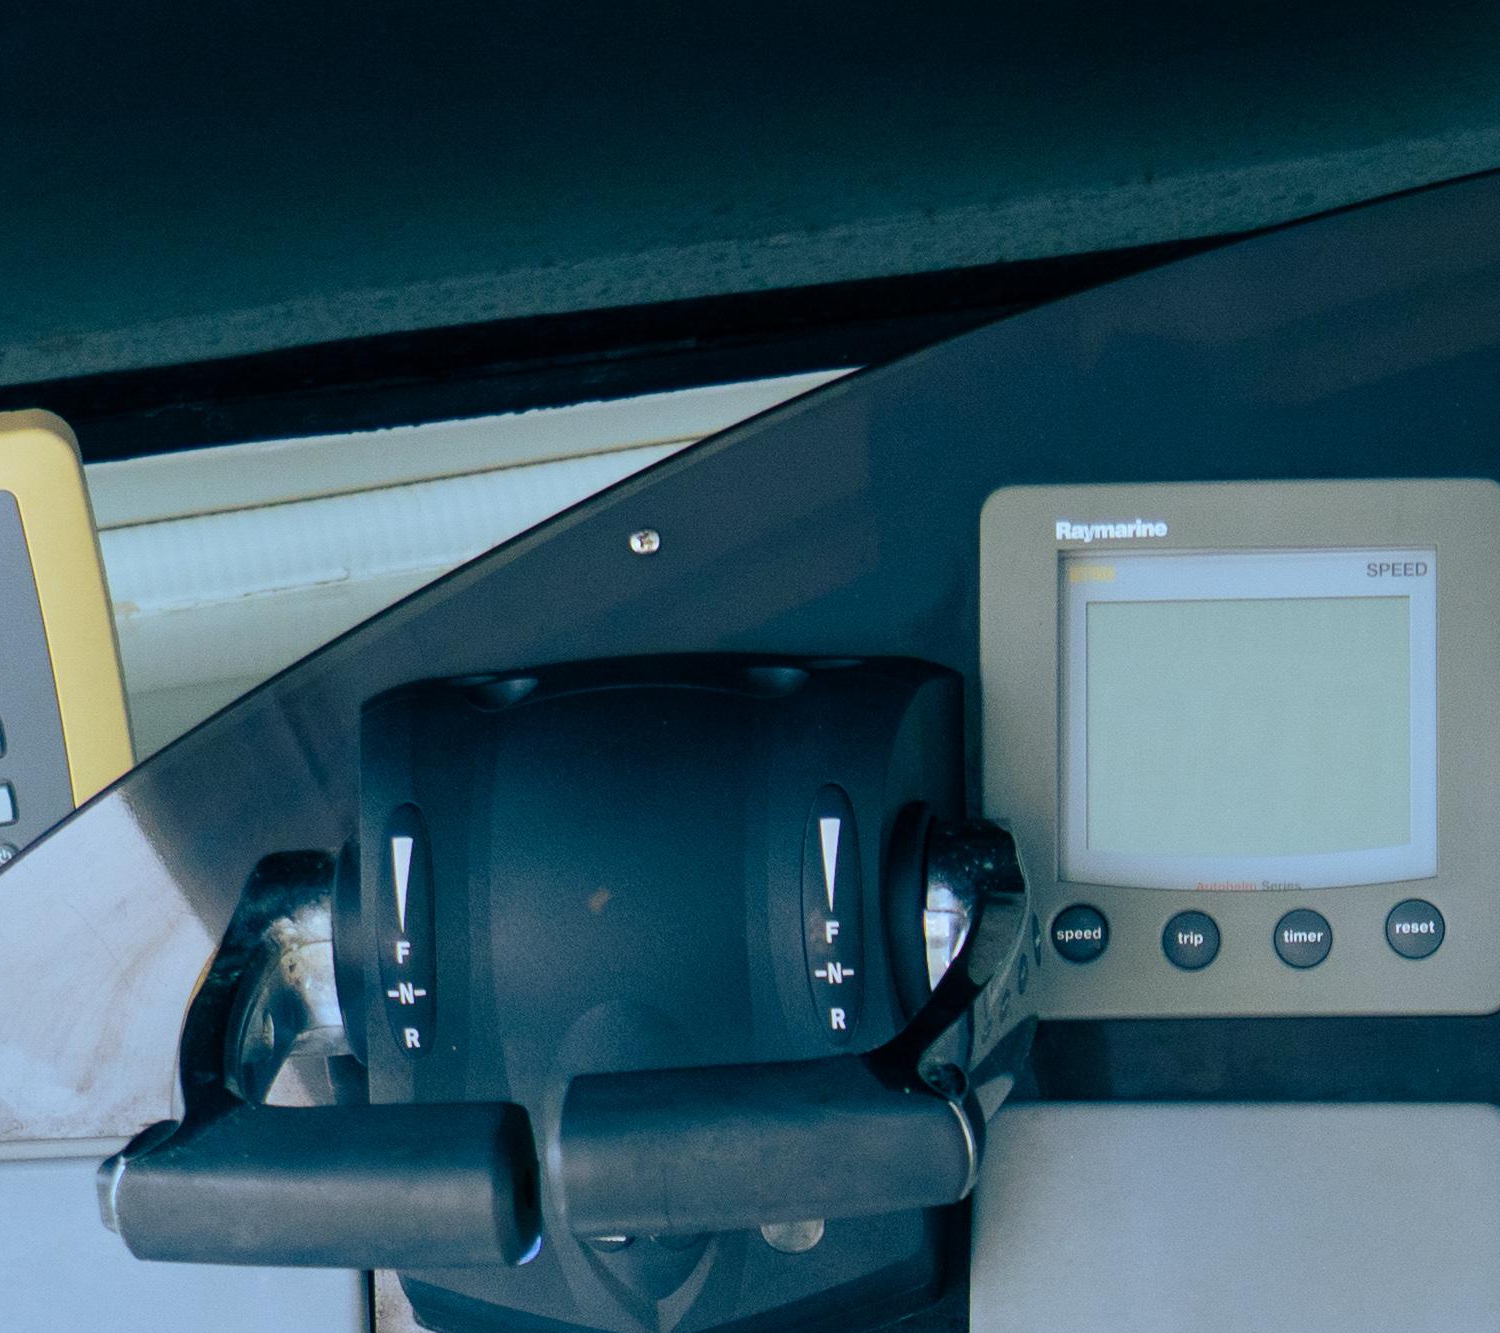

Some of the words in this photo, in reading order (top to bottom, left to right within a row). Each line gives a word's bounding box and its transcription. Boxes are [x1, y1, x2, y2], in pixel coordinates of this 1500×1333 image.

[1056, 519, 1168, 543] Raymarine
[1367, 563, 1428, 577] SPEED
[1262, 881, 1301, 891] Series
[826, 921, 840, 944] F
[1056, 926, 1102, 942] speed
[1395, 920, 1435, 934] reset
[1178, 932, 1203, 947] trip
[1283, 929, 1323, 943] timer
[396, 941, 411, 964] F
[830, 1007, 846, 1030] R
[404, 1027, 421, 1049] R
